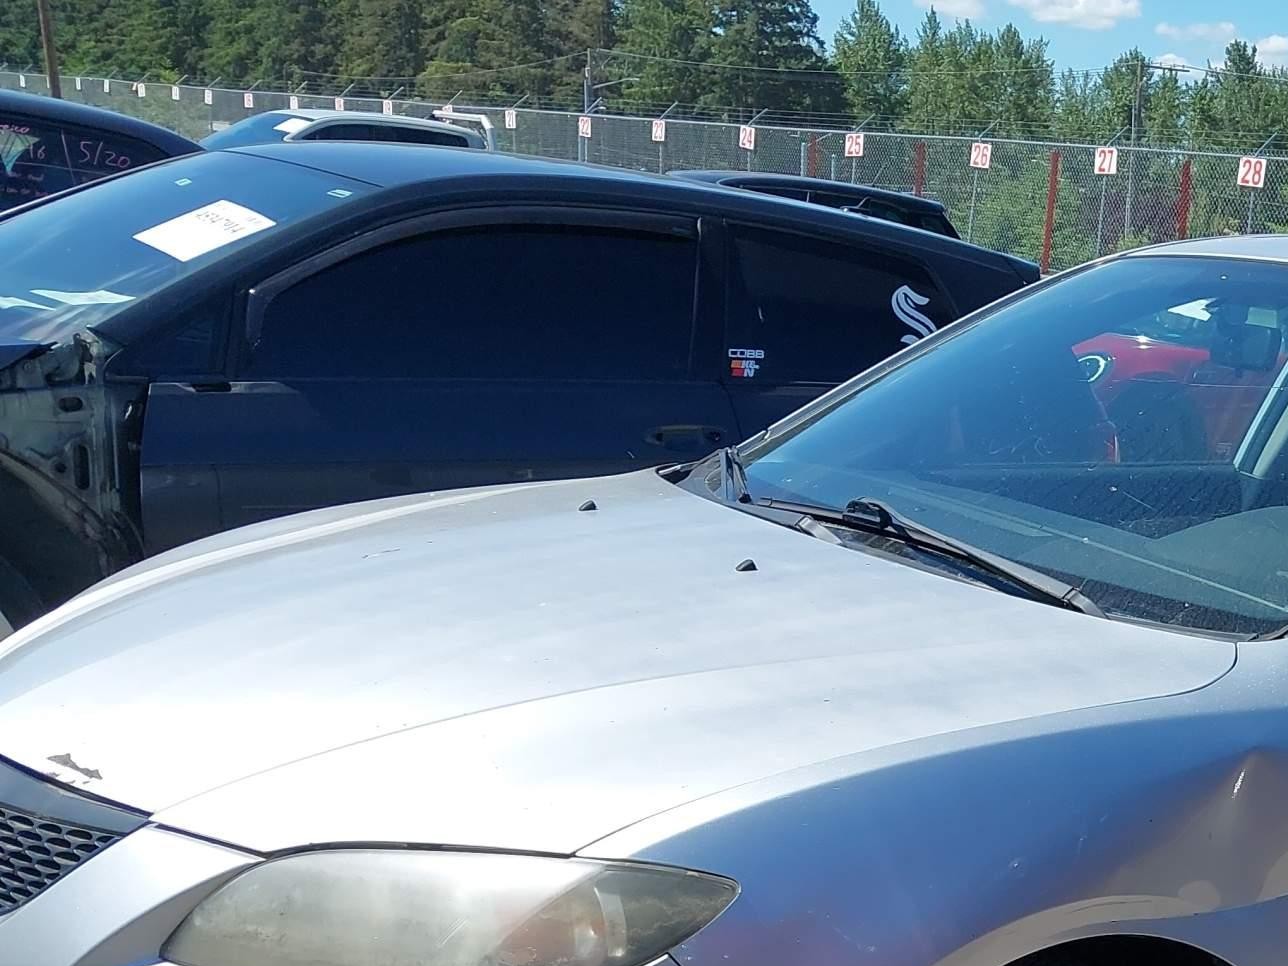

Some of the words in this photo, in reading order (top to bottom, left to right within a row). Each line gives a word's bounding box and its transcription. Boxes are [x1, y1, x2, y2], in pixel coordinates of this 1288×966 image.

[506, 111, 515, 127] 21
[580, 118, 590, 135] 22
[653, 122, 664, 140] 23
[741, 128, 753, 147] 24
[847, 135, 861, 155] 25
[79, 141, 131, 169] 5/20
[972, 145, 989, 166] 26
[1098, 149, 1114, 172] 27
[1240, 159, 1263, 186] 28
[728, 348, 765, 359] COBB
